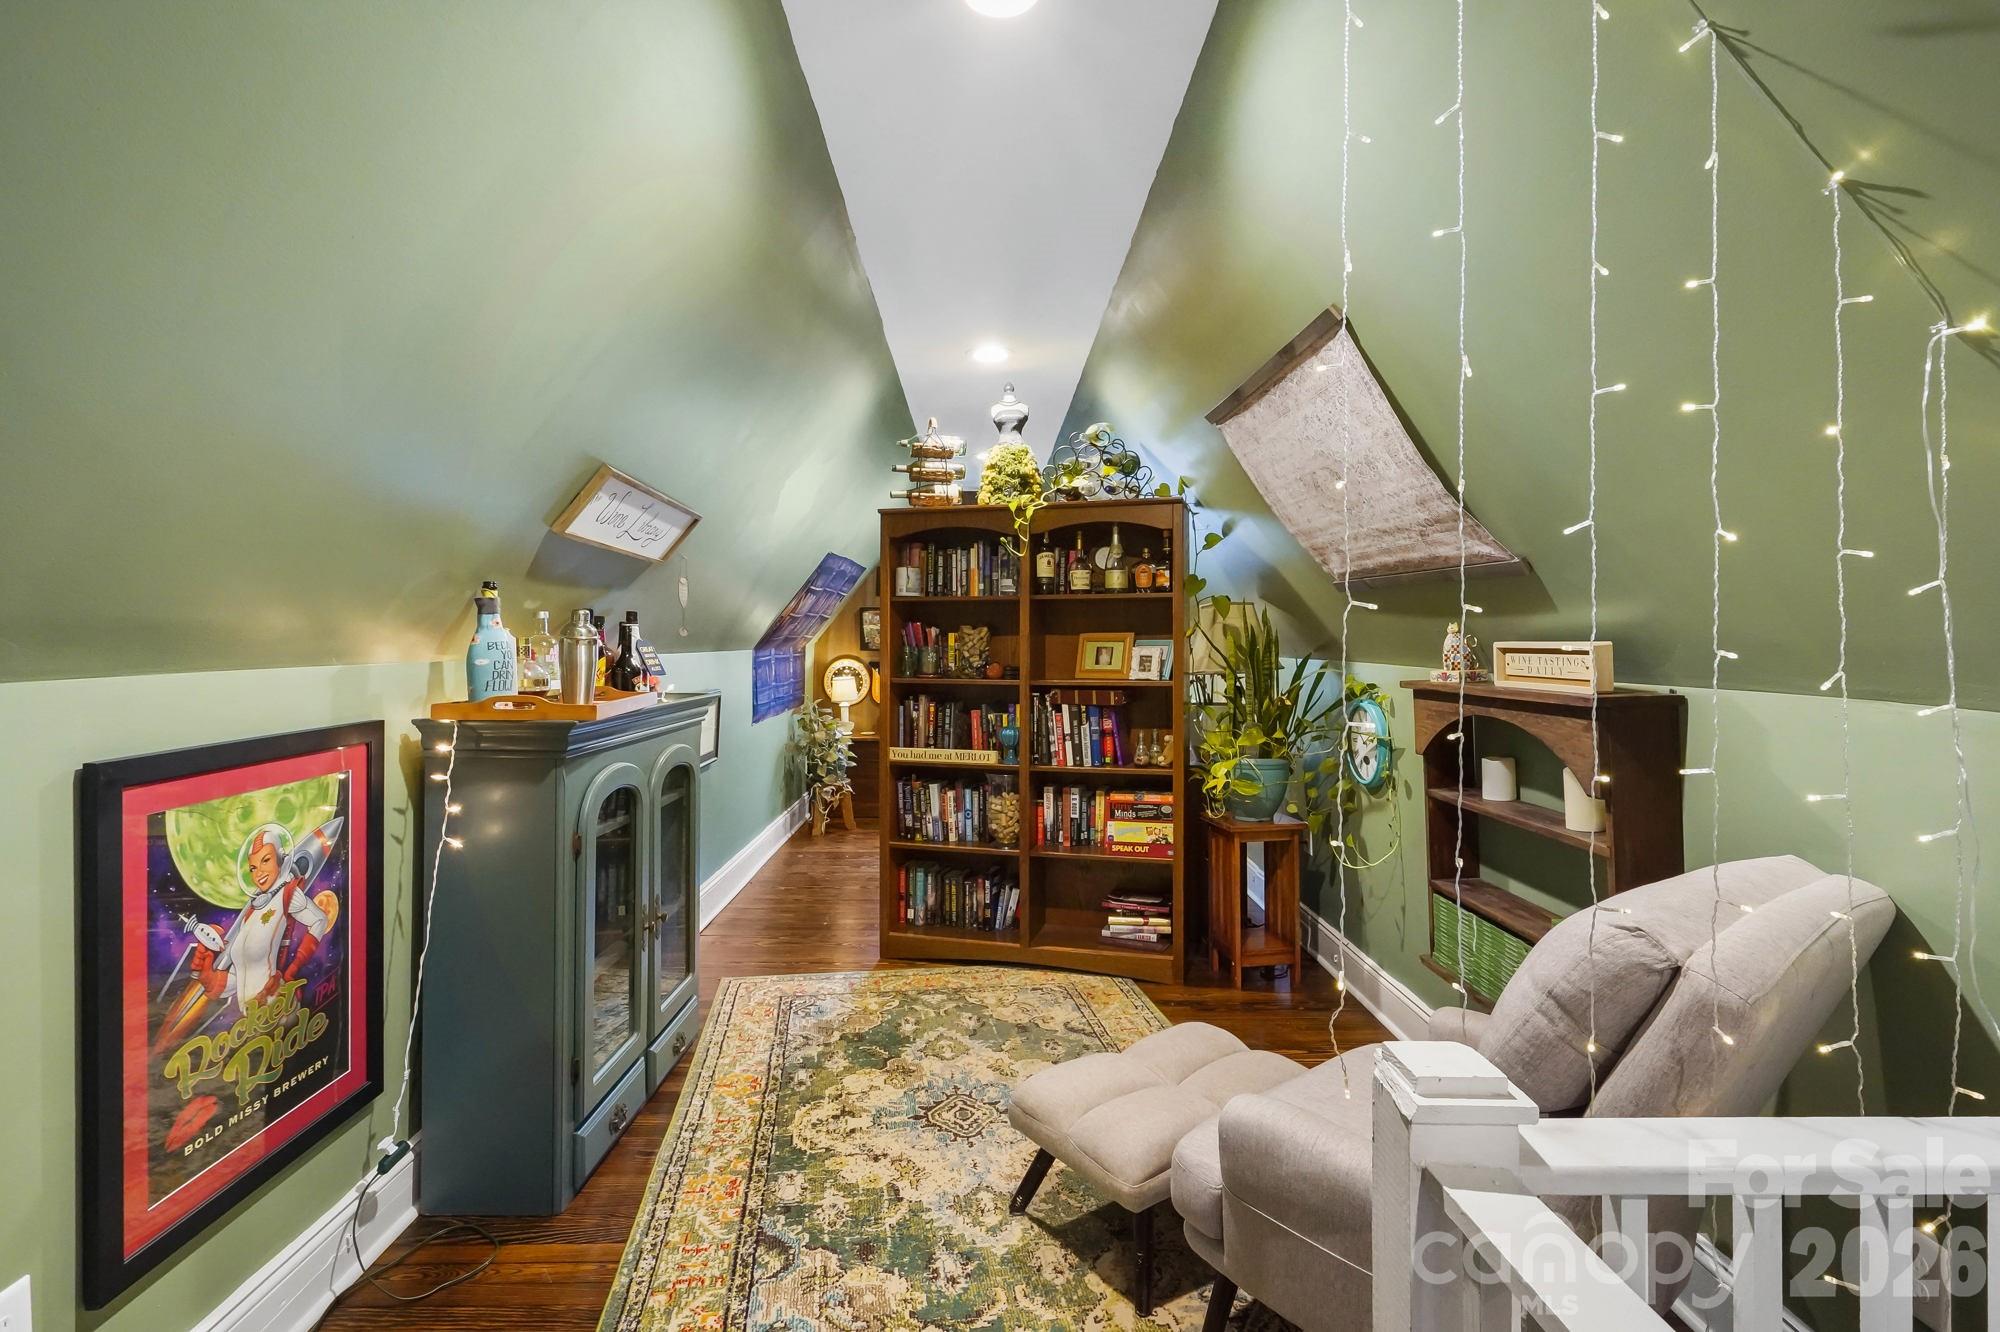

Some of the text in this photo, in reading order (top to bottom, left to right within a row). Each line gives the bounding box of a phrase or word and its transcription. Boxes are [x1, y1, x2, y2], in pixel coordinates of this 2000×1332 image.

[1510, 655, 1587, 667] WINE TASTINGS
[1527, 666, 1563, 676] DAILY
[891, 749, 909, 759] You
[910, 750, 927, 760] had
[954, 753, 992, 762] MERLOT
[1114, 810, 1137, 818] Minds
[1111, 844, 1150, 853] SPEAK OUT
[164, 978, 308, 1100] Rocket
[222, 1007, 329, 1106] Ride
[184, 1056, 329, 1157] BOLD MISSY BREWERY
